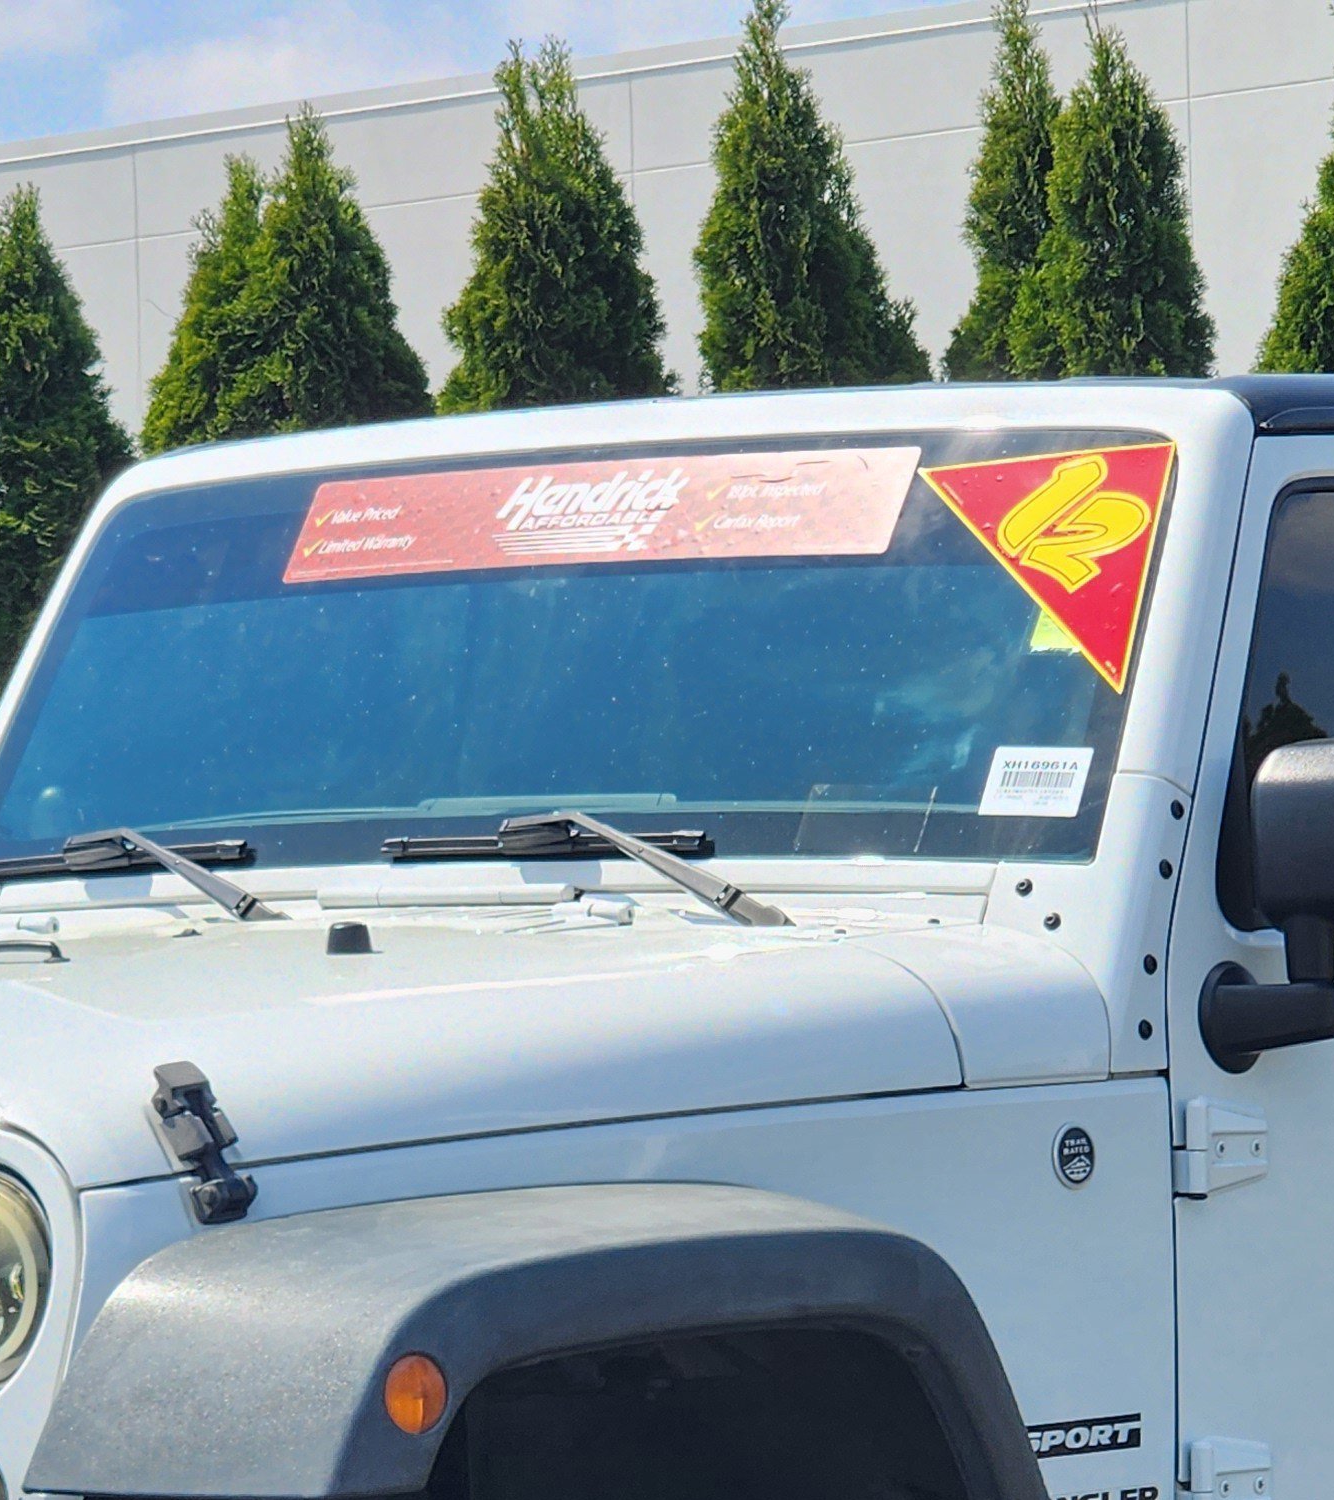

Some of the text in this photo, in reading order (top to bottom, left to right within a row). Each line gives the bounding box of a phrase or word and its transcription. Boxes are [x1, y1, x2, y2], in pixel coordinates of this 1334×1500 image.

[496, 467, 690, 531] Hendrick
[331, 504, 404, 525] Value Priced
[519, 510, 667, 531] AFFORDABLE
[318, 533, 417, 554] Limited Warranty
[1063, 1146, 1090, 1156] RATED
[1064, 1138, 1088, 1147] TRAIL
